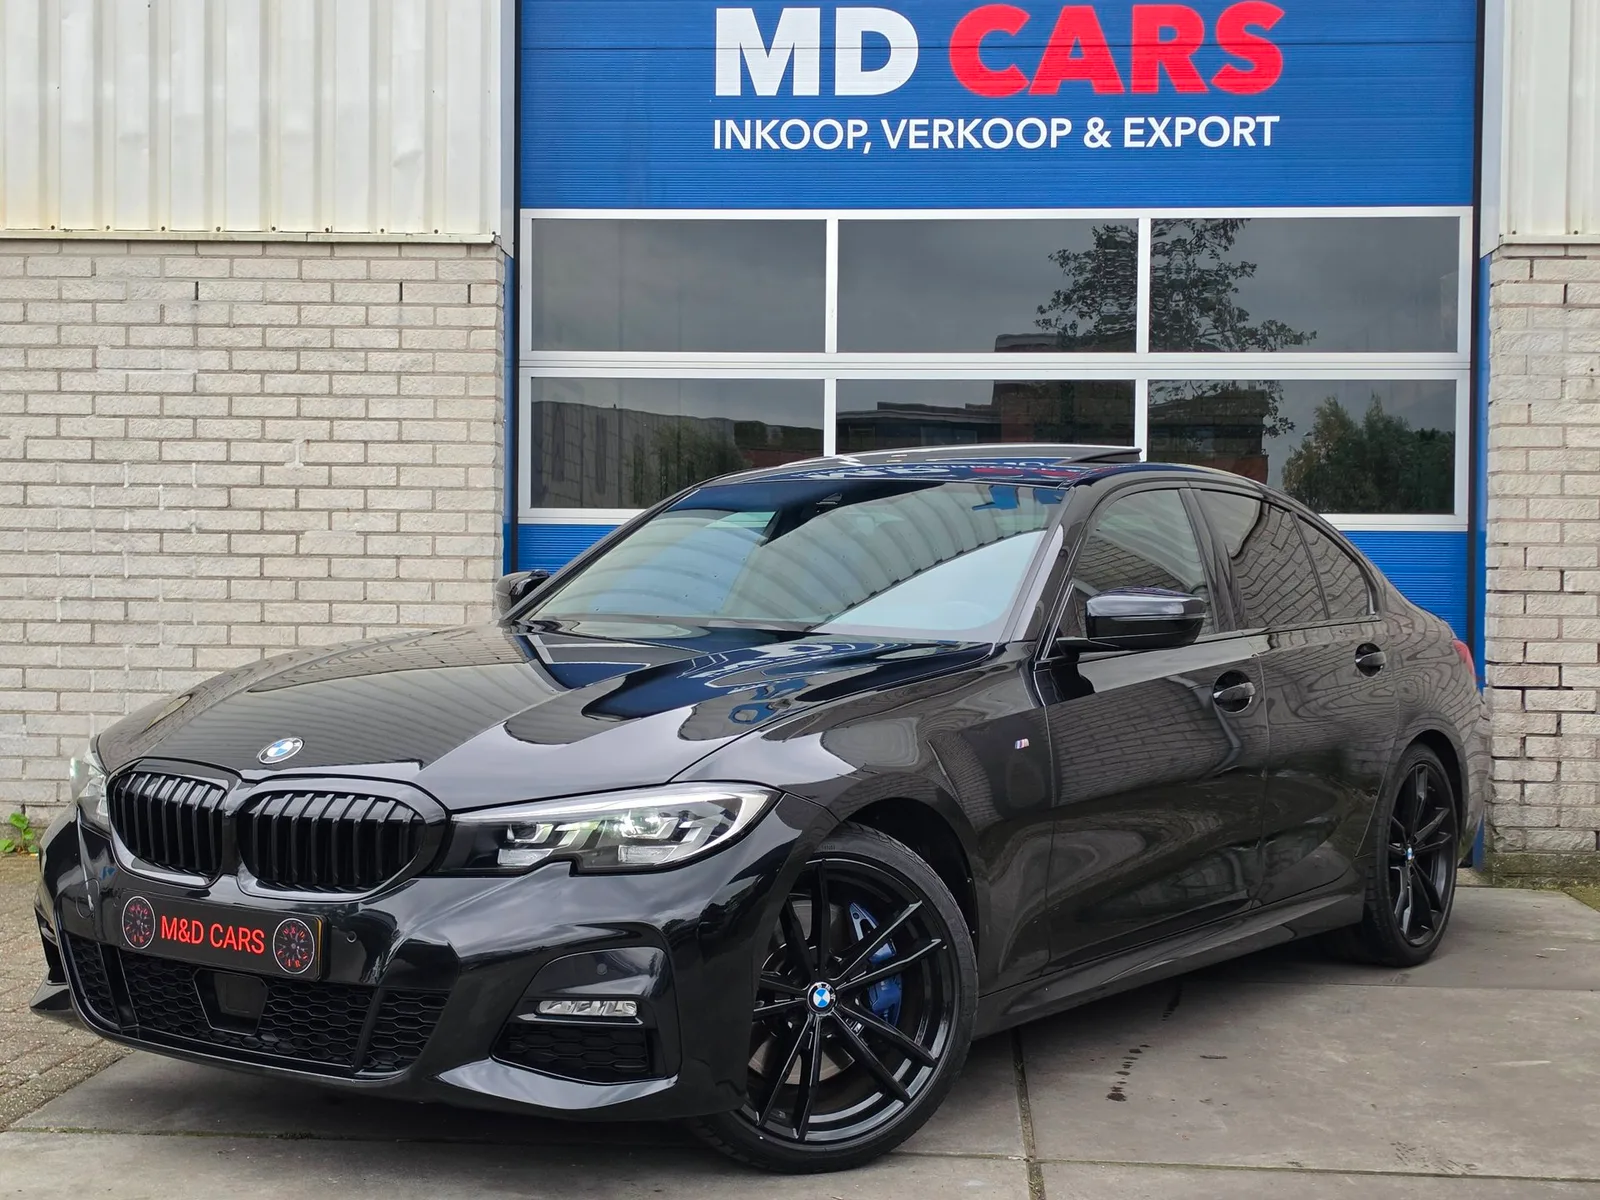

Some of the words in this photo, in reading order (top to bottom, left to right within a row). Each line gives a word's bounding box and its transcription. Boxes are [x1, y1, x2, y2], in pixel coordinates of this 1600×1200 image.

[715, 7, 919, 97] MD
[949, 1, 1285, 97] CARS
[714, 118, 872, 154] INKOOP,
[880, 117, 1072, 150] VERKOOP
[1084, 116, 1112, 149] &
[1124, 115, 1280, 148] EXPORT
[160, 915, 205, 945] M&D
[209, 923, 266, 955] CARS
